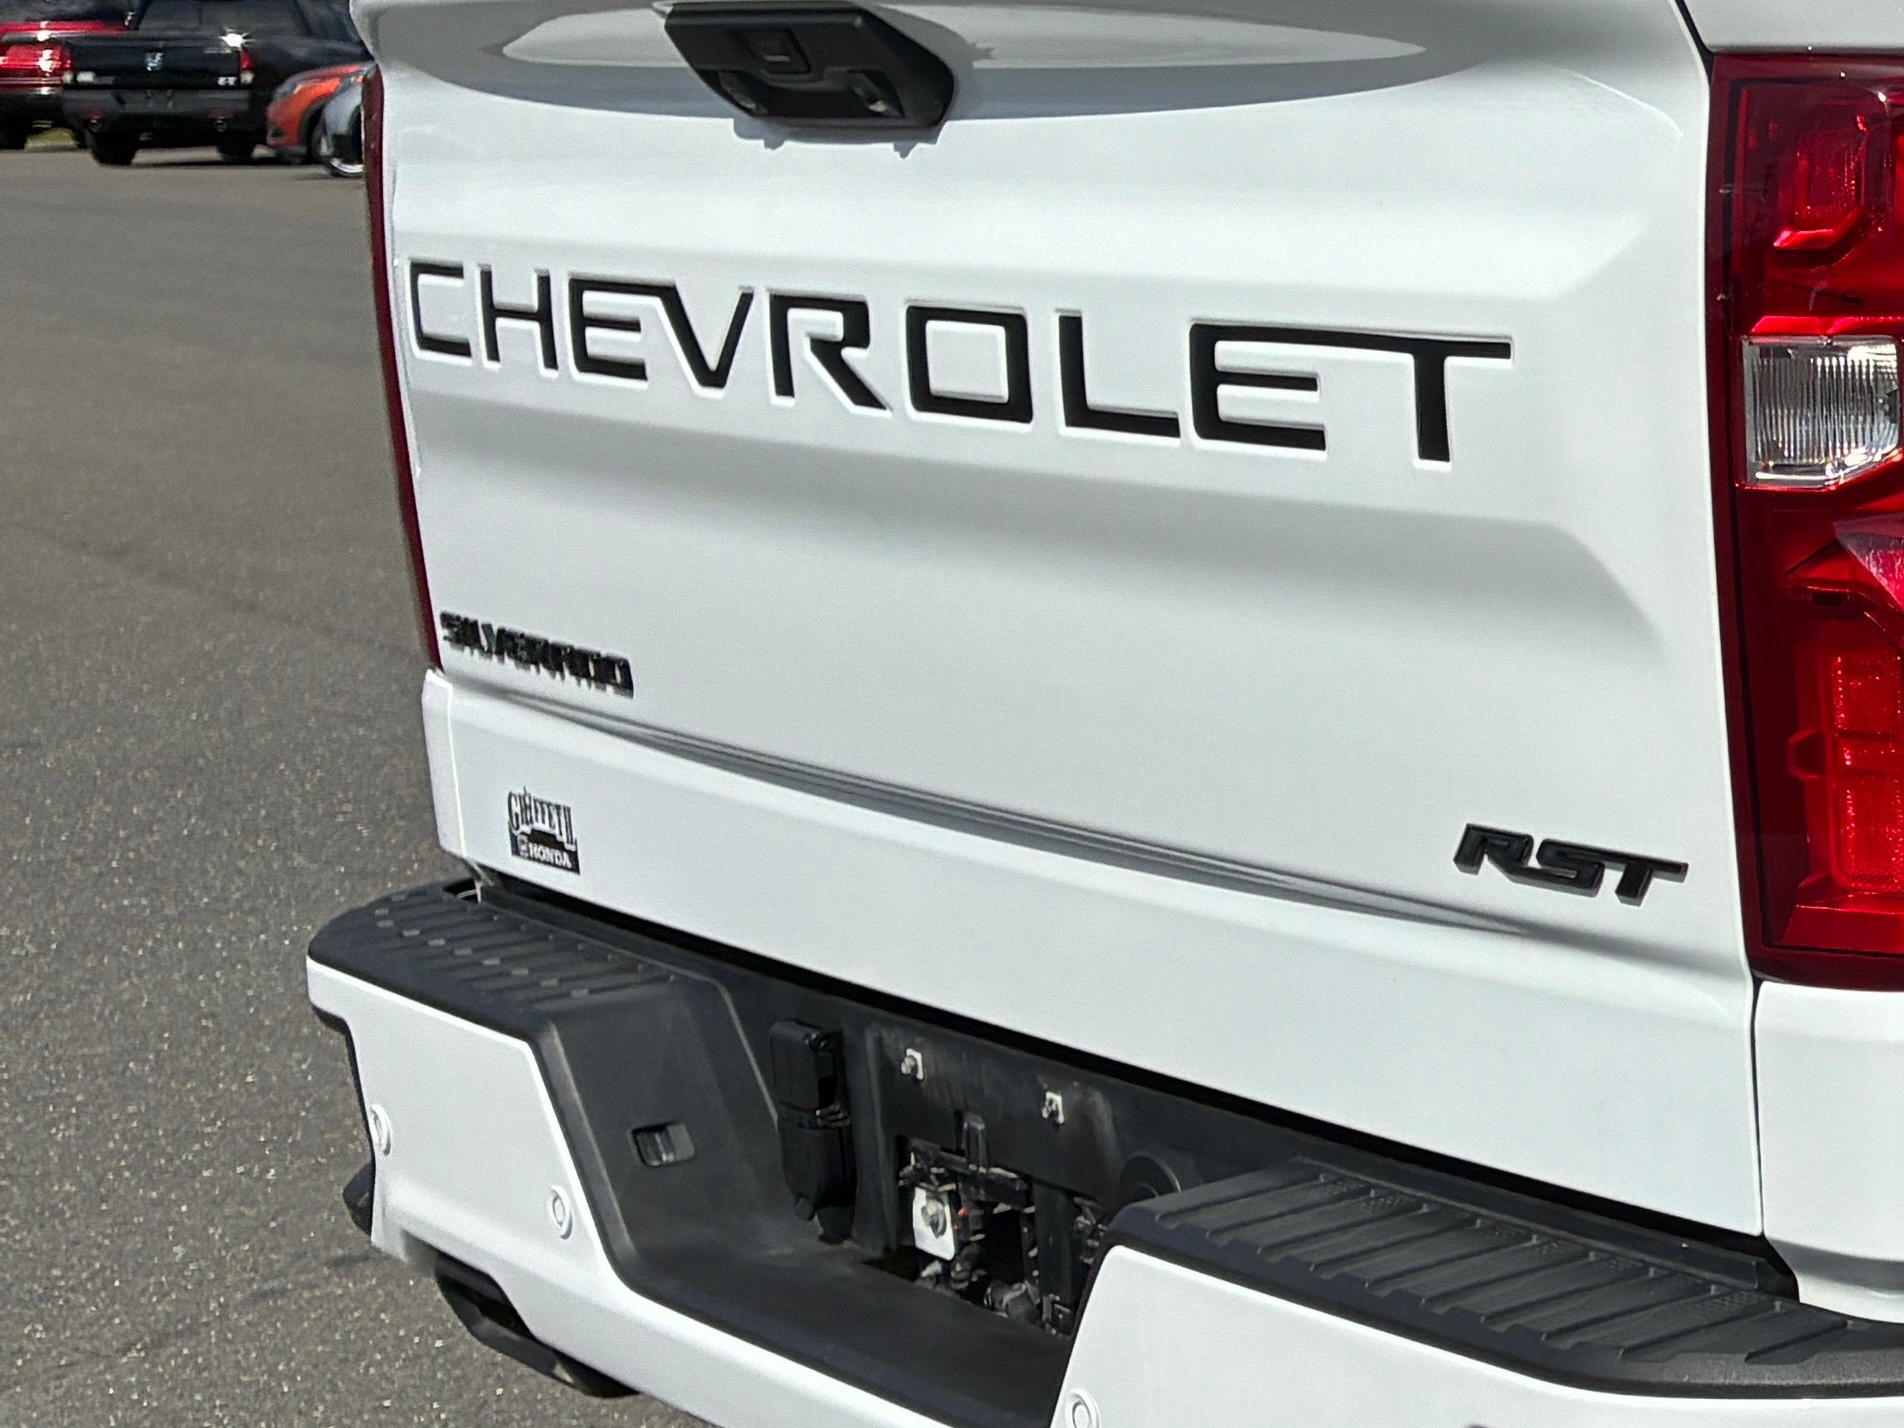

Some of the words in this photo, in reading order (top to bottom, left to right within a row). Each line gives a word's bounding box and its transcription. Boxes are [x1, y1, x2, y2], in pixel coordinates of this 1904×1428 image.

[408, 261, 1512, 466] CHEVROLET
[440, 610, 635, 699] SILVERADO
[528, 842, 573, 869] HONDA
[1453, 823, 1689, 907] RST
